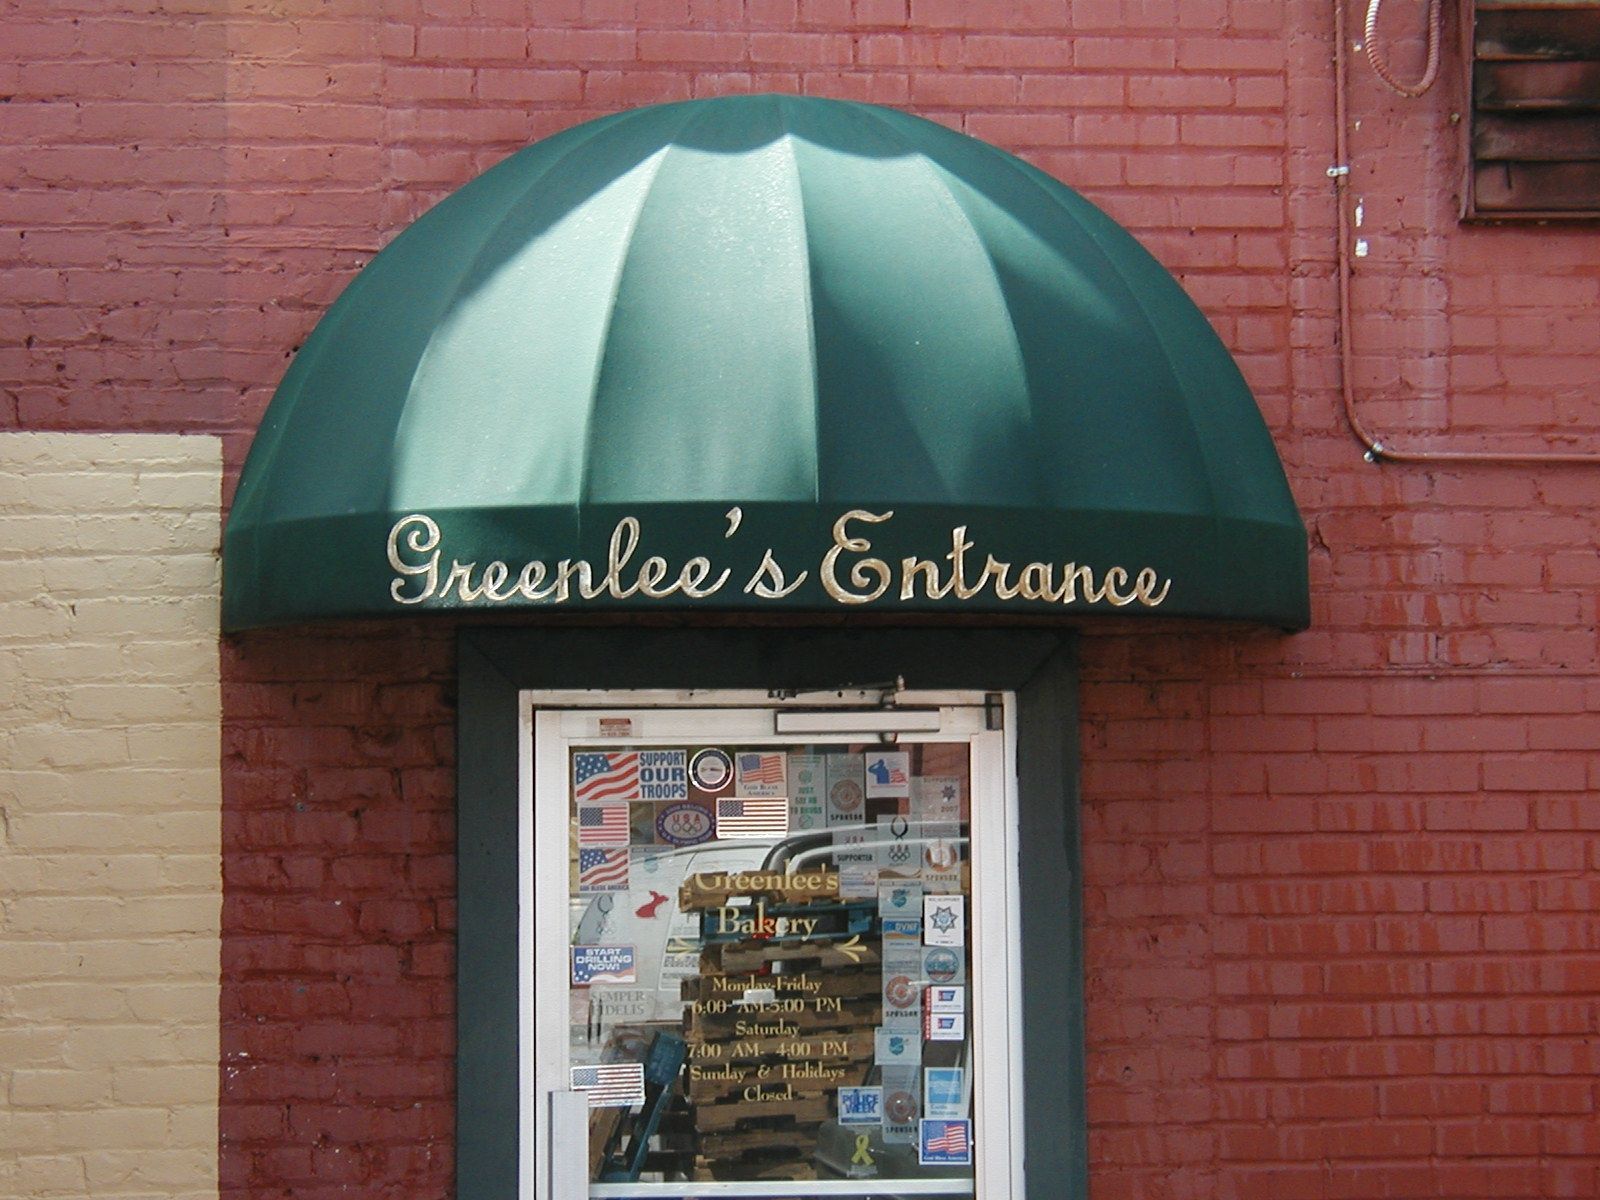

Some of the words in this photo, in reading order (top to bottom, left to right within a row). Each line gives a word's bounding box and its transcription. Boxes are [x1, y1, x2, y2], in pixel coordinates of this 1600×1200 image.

[387, 506, 808, 604] Greenlee's
[820, 508, 1173, 607] Entrance
[639, 752, 685, 766] SUPPORT
[639, 767, 685, 782] OUR
[640, 783, 687, 799] TROOPS
[830, 814, 863, 822] SPONSOR
[837, 853, 873, 861] SUPPORTER
[695, 859, 839, 891] Greenlee's
[717, 901, 818, 941] Bakery
[575, 955, 632, 964] DRILLING
[586, 948, 621, 956] START
[587, 962, 620, 971] NOW!
[691, 999, 728, 1014] 6:00
[815, 997, 842, 1012] PM
[885, 1010, 918, 1018] SPONSOR
[735, 1018, 800, 1037] Saturday
[686, 1043, 721, 1058] 7:00
[774, 1041, 811, 1057] 4:00
[822, 1041, 849, 1056] PM
[691, 1062, 747, 1083] Sunday
[757, 1064, 771, 1079] &
[782, 1061, 846, 1083] Holidays
[743, 1084, 793, 1101] Closed
